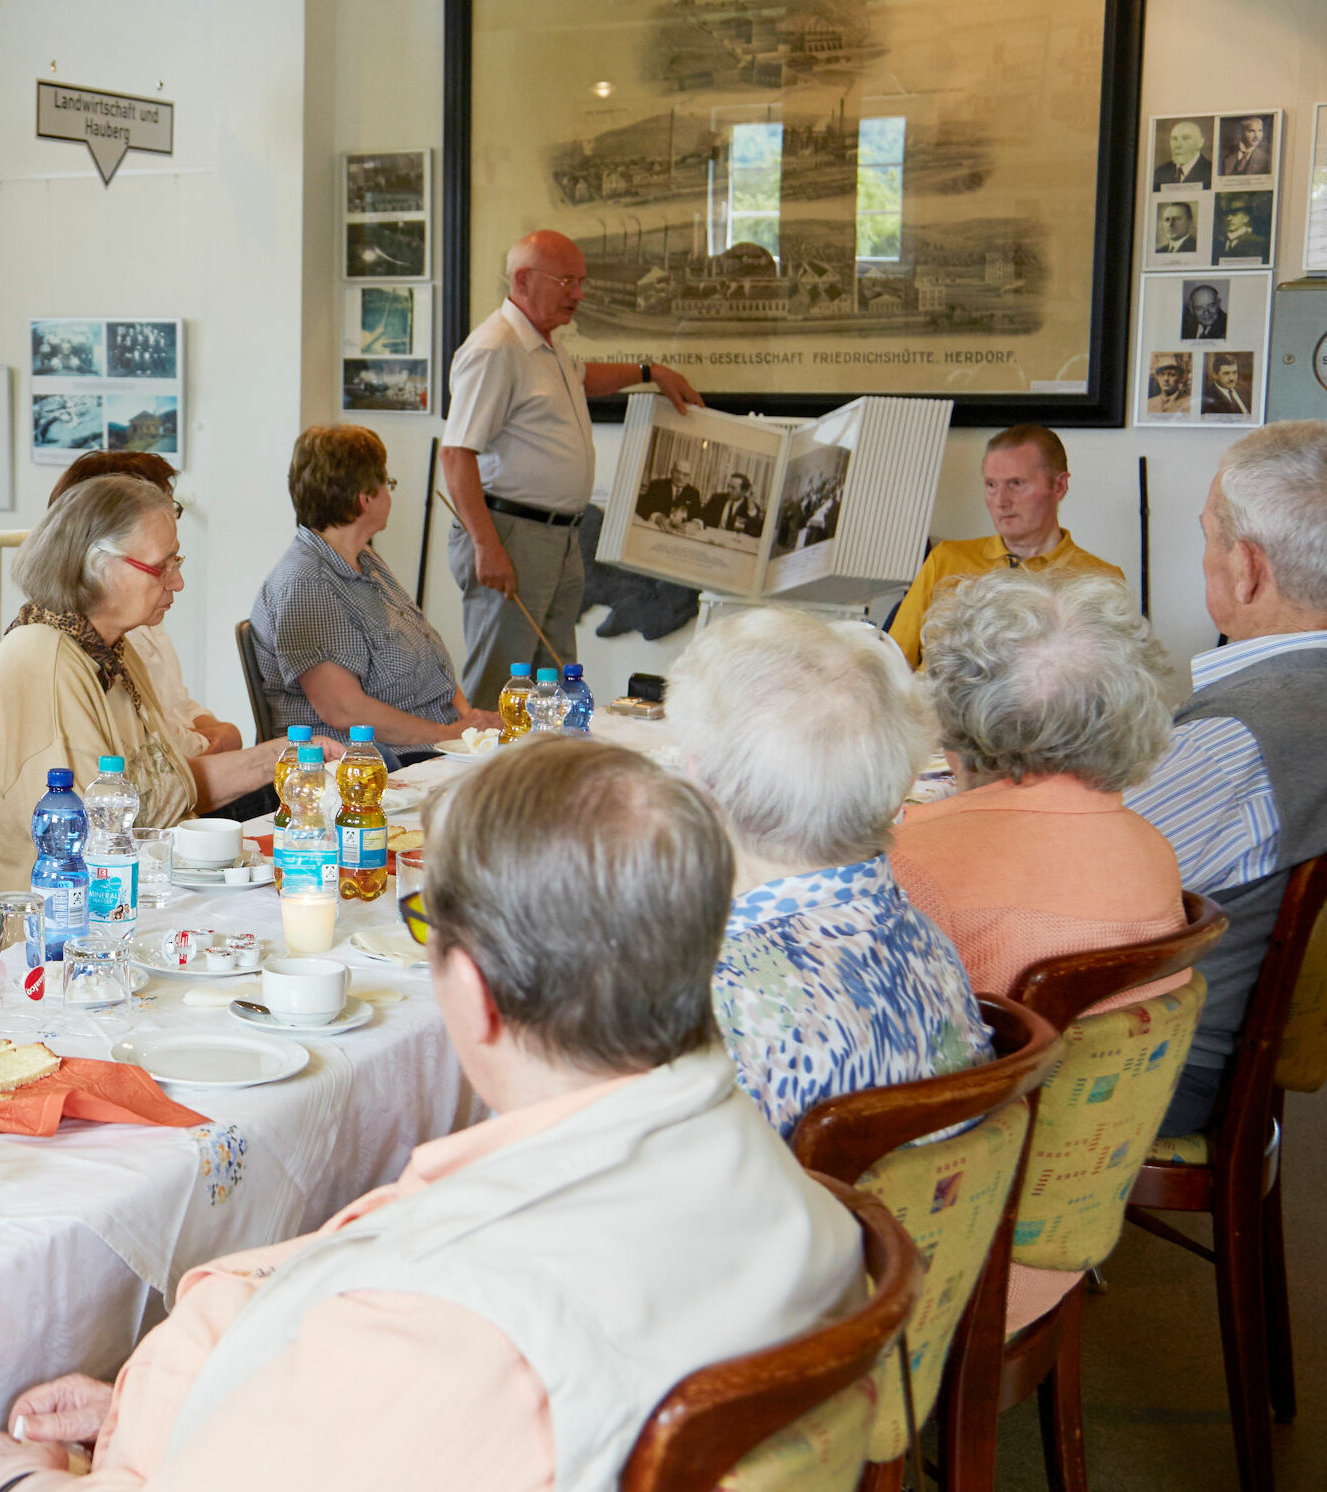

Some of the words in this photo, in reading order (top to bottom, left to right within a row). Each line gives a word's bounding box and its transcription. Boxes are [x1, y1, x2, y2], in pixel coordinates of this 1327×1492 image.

[53, 90, 136, 120] Landwirtschaft
[139, 106, 159, 124] und
[84, 116, 130, 145] Hauberg
[944, 350, 1018, 365] HERDORF.
